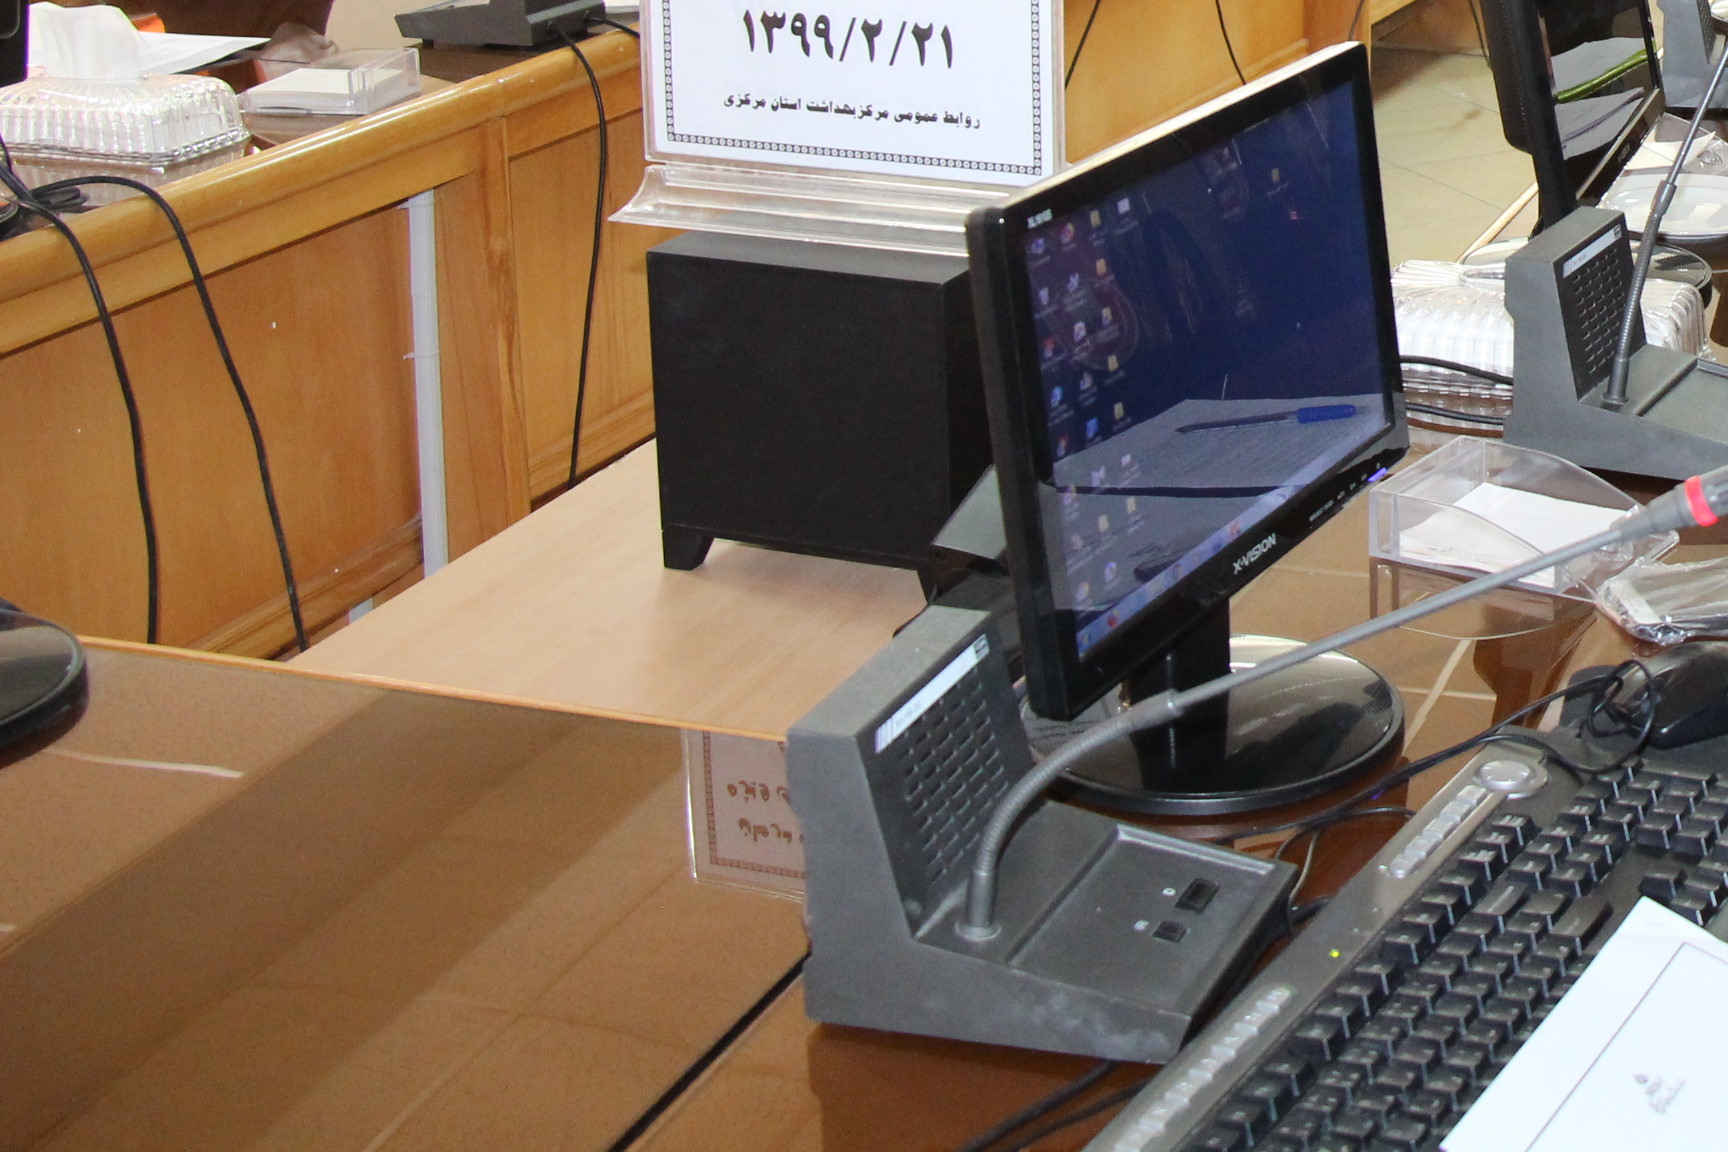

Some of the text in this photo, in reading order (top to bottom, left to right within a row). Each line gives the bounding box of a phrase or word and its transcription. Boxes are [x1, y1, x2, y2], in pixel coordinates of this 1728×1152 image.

[742, 9, 953, 69] ۱۳۹۹/۲/۲۱
[723, 93, 766, 110] مرکزی
[770, 95, 802, 112] استان
[893, 109, 939, 126] عمومی
[942, 109, 981, 130] روابط
